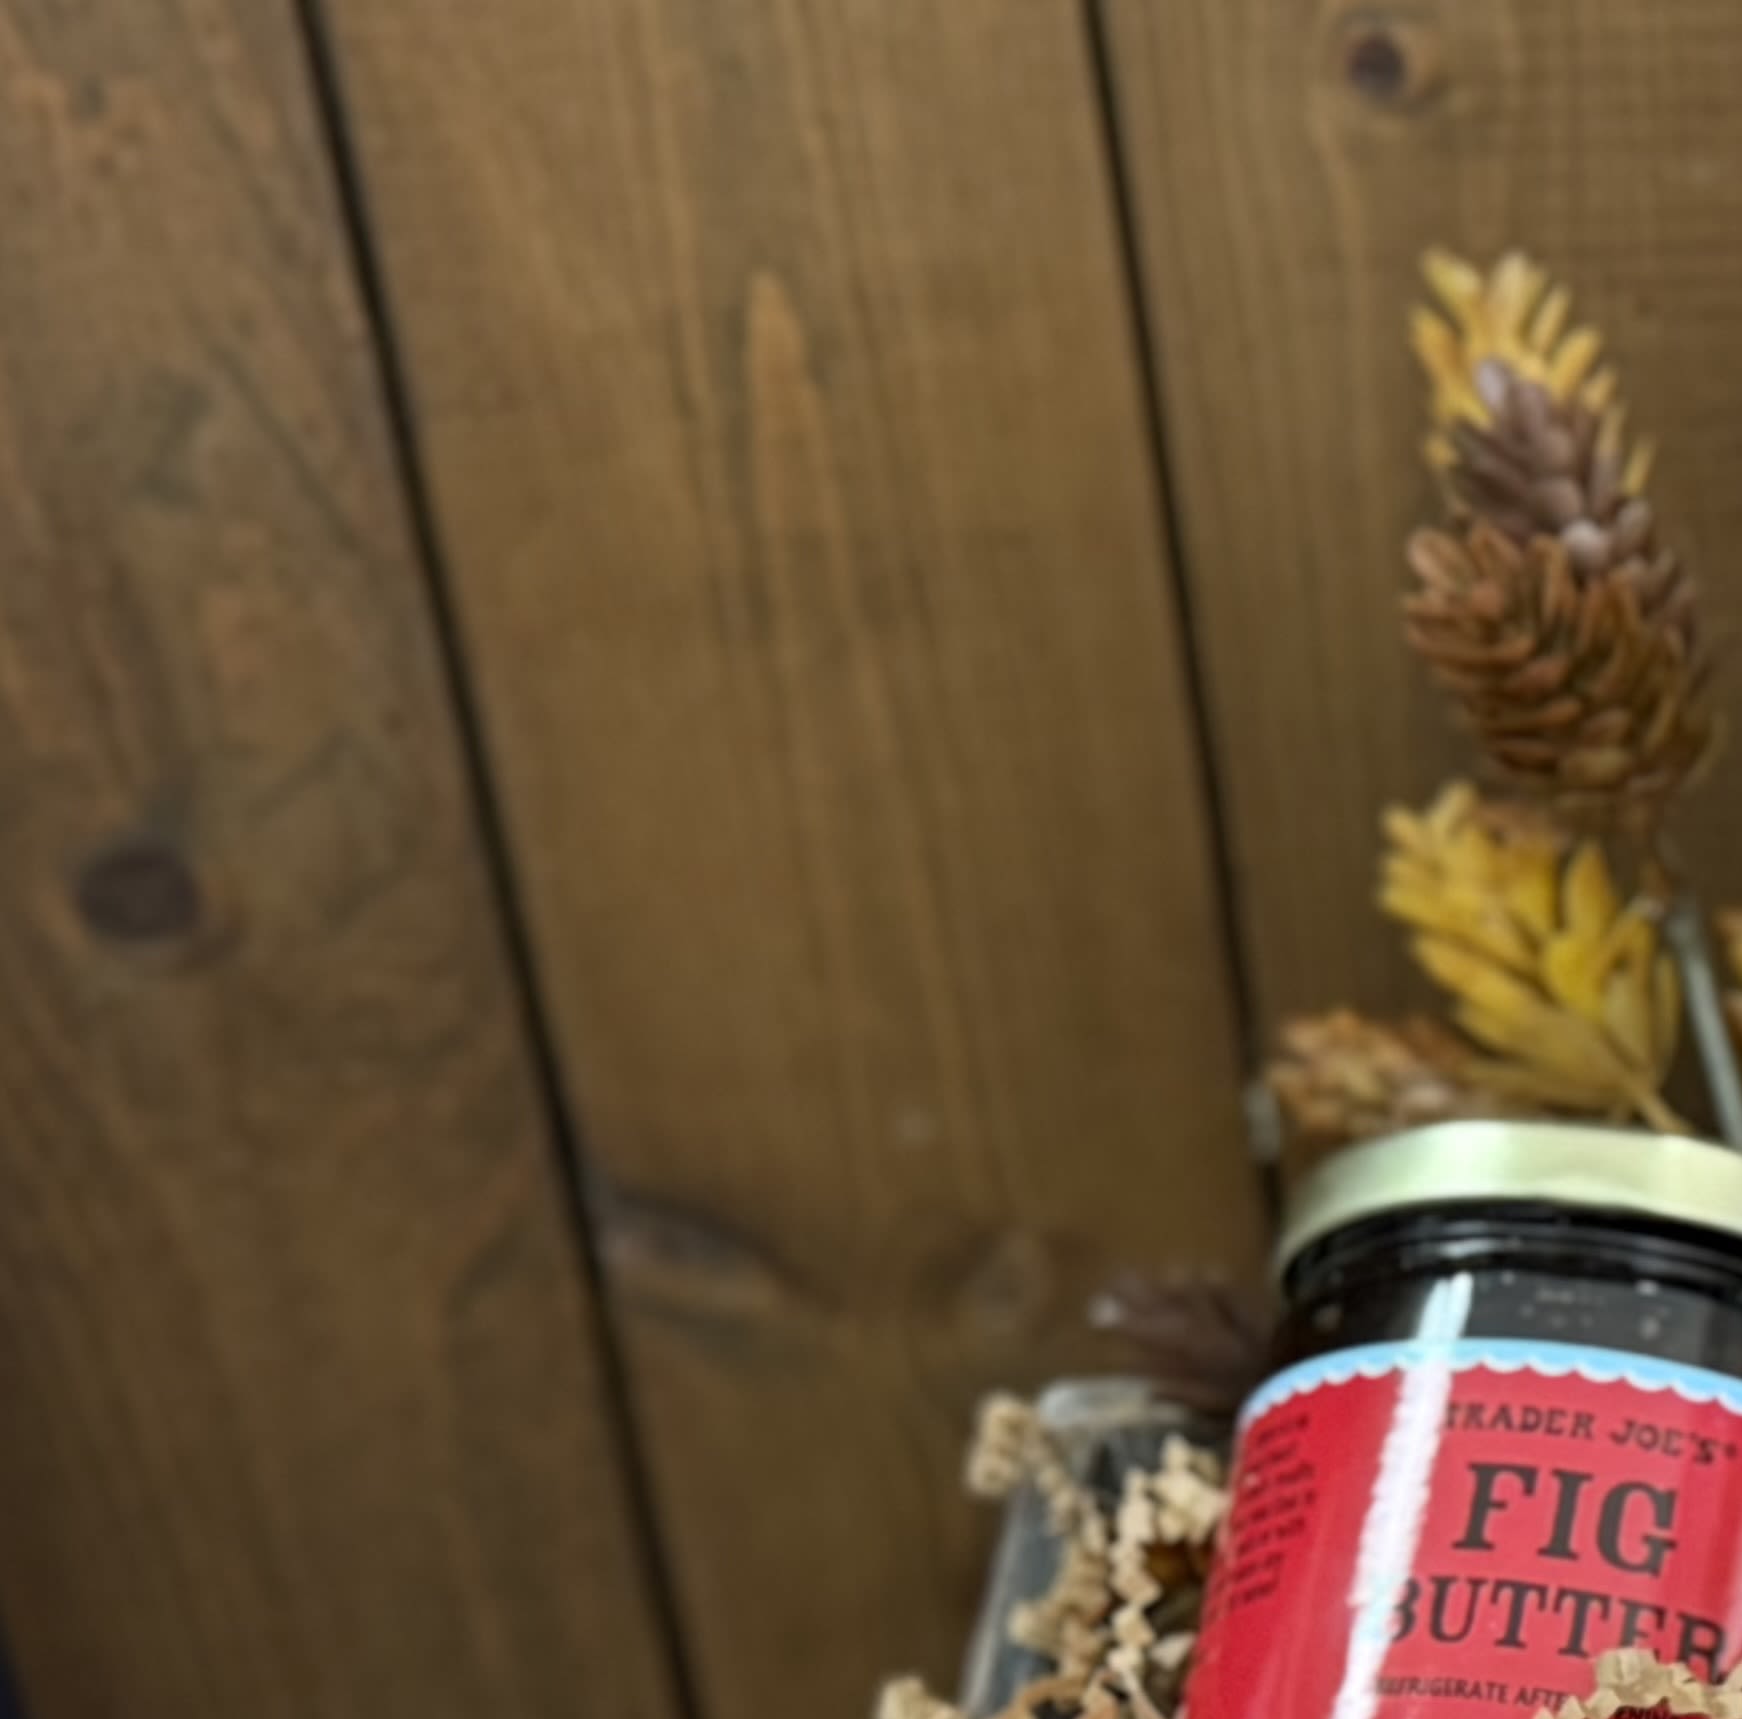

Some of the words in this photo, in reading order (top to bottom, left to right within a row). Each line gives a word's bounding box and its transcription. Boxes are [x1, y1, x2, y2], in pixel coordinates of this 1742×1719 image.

[1444, 1401, 1597, 1441] TRADER
[1450, 1460, 1679, 1579] FIG
[1515, 1686, 1571, 1709] AFTE
